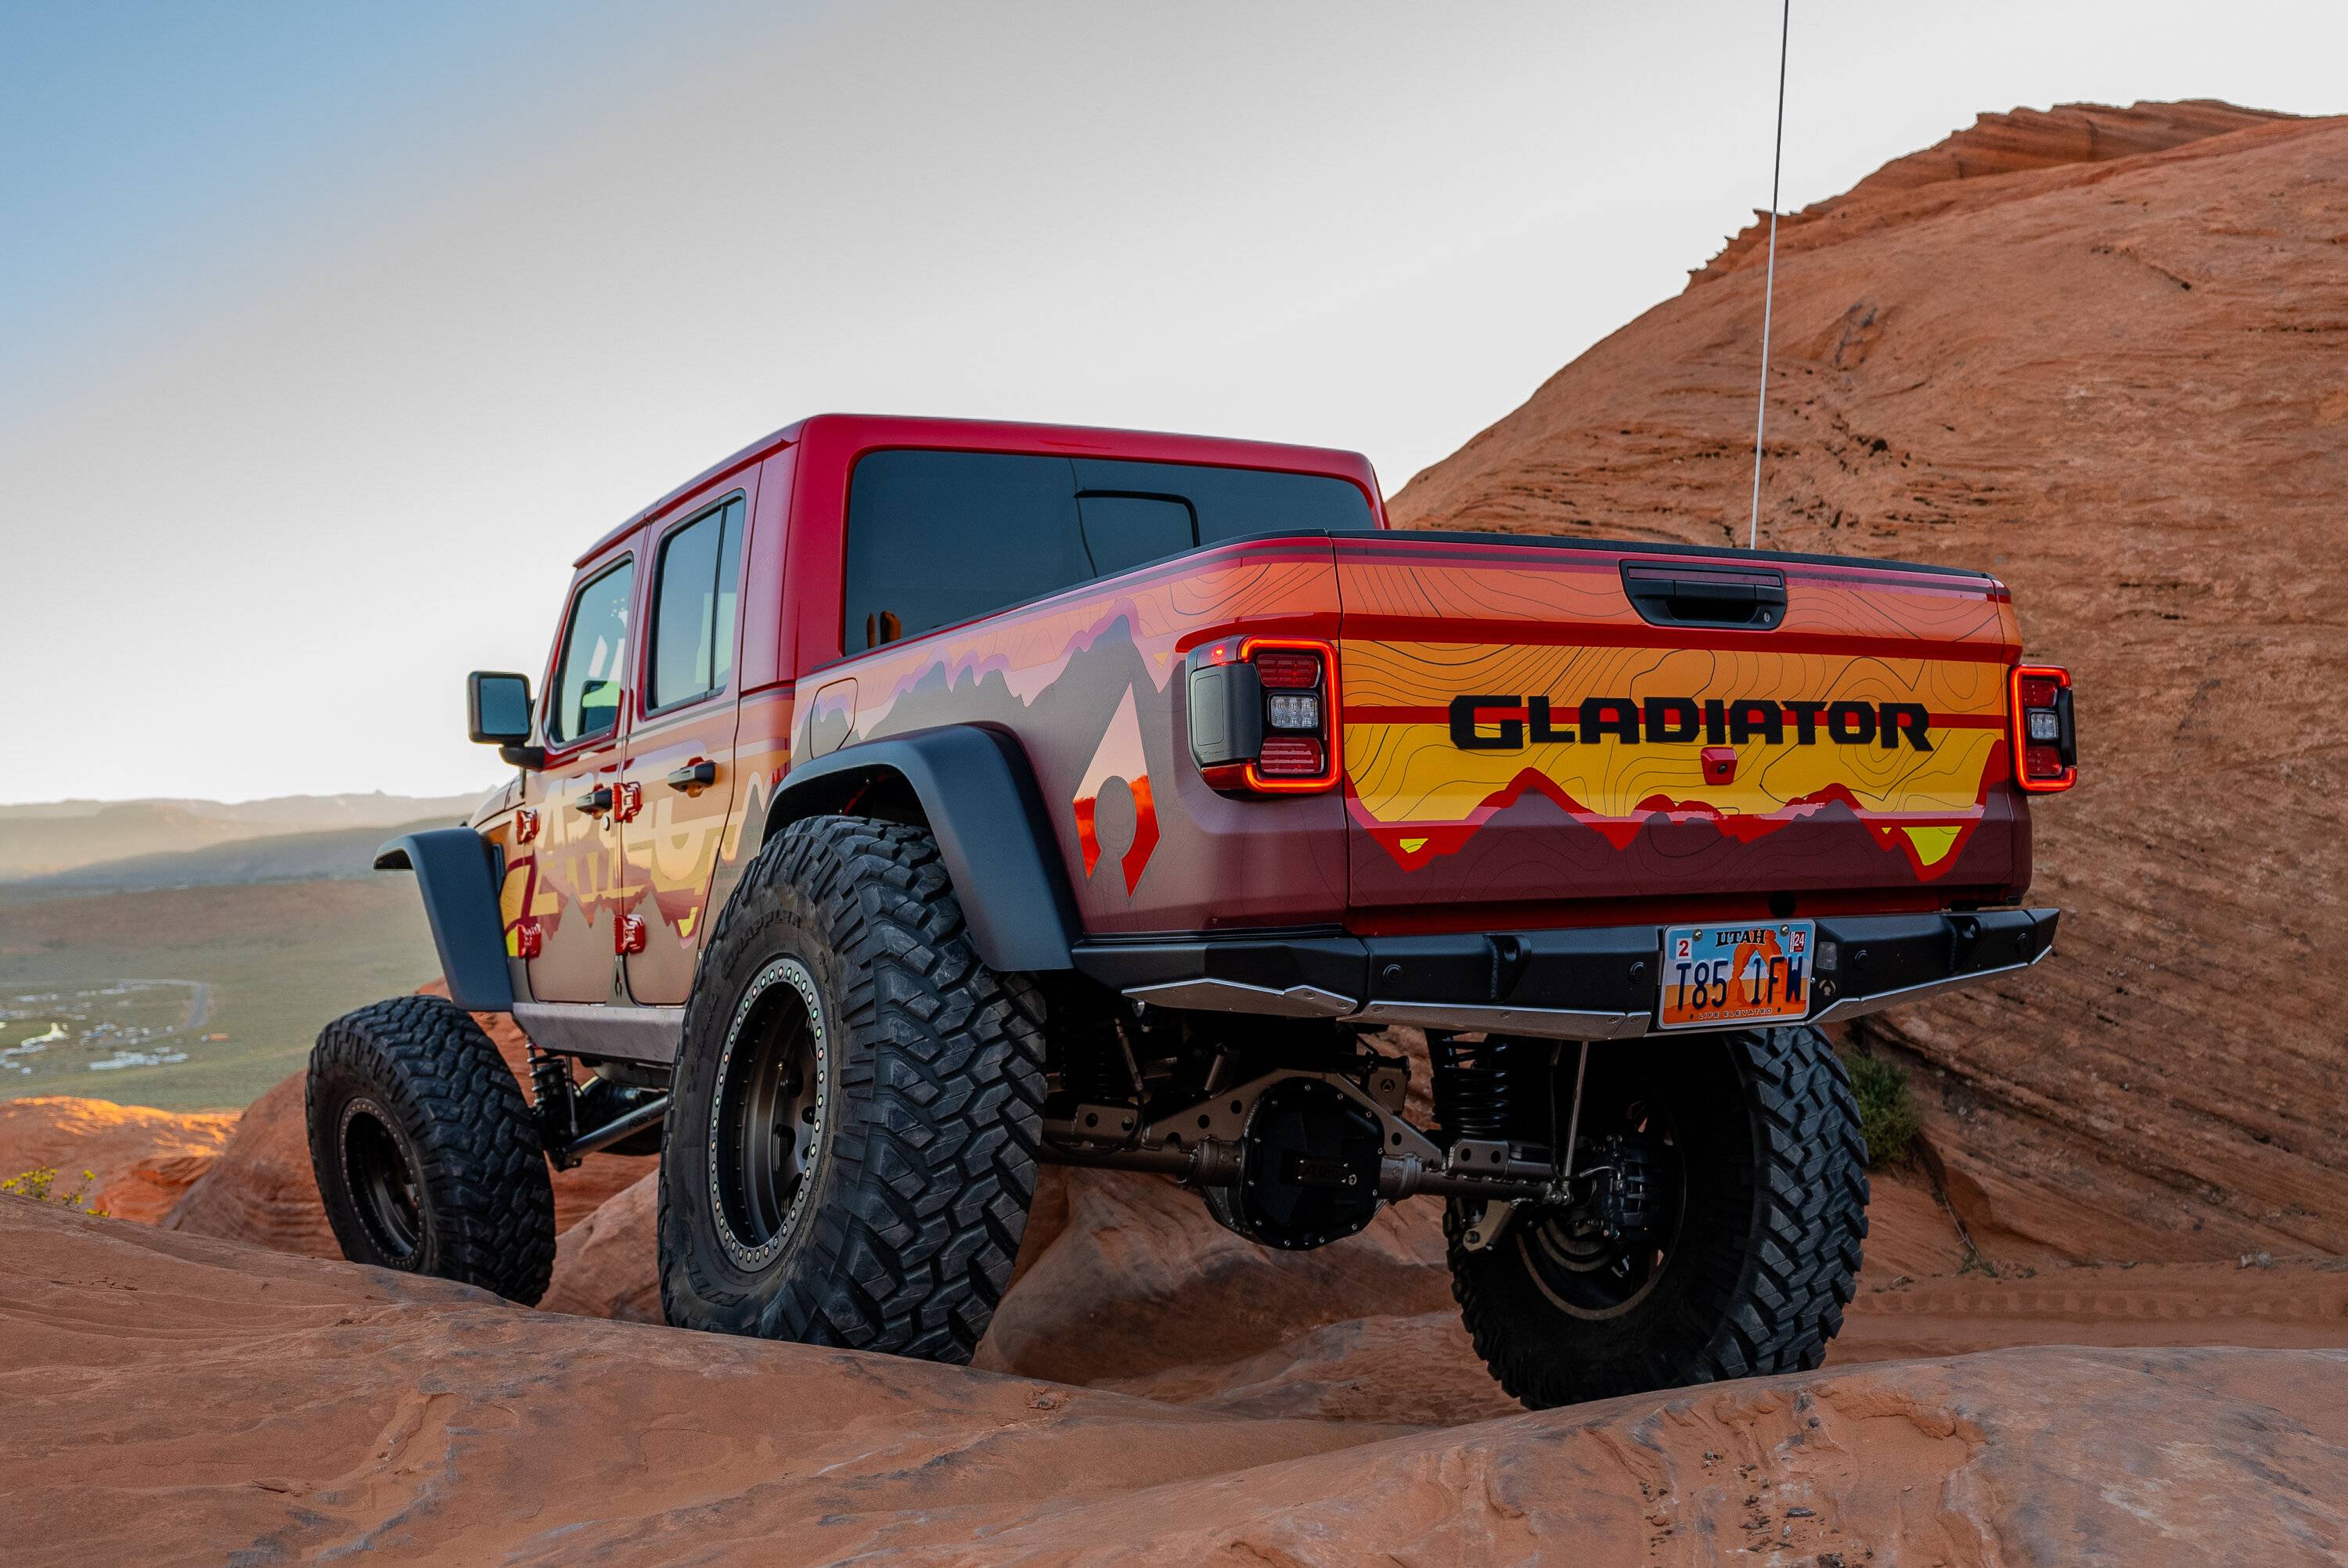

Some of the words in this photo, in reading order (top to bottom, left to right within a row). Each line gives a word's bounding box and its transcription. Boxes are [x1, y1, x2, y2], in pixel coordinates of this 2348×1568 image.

[1449, 695, 1934, 752] GLADIATOR
[1716, 929, 1766, 948] UTAH
[1794, 933, 1805, 947] 24
[1678, 940, 1690, 957] 2
[1676, 959, 1729, 1011] T85
[1751, 955, 1803, 1005] 1FW
[1698, 1011, 1720, 1020] LIFE
[1723, 1008, 1773, 1017] ELEVATED
